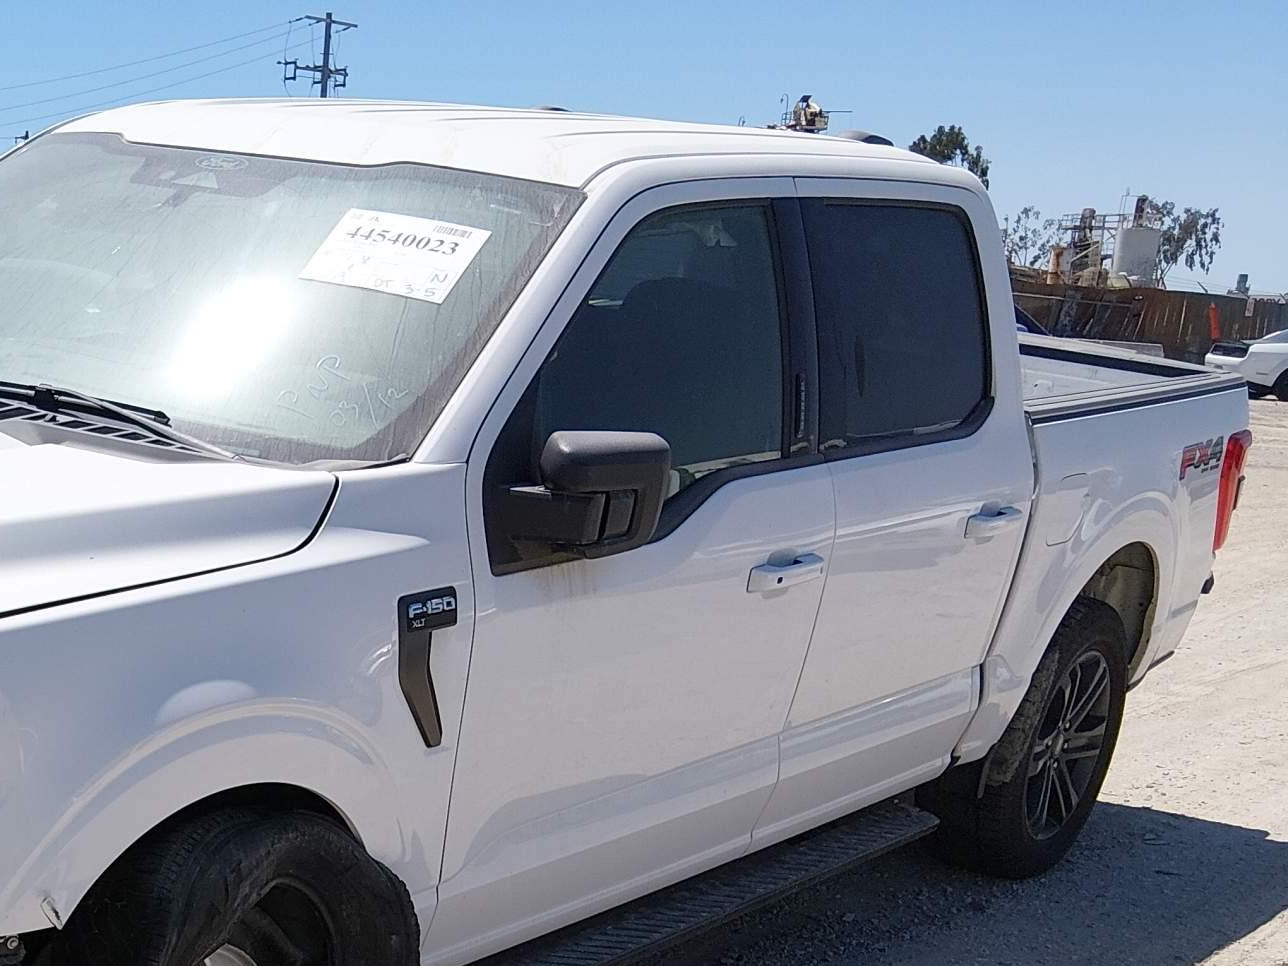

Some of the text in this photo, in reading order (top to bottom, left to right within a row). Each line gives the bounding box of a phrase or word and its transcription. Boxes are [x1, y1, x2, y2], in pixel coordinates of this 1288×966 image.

[346, 225, 460, 256] 44540023
[1179, 436, 1224, 480] FX4
[408, 596, 456, 618] F-150
[412, 618, 425, 628] XLT
